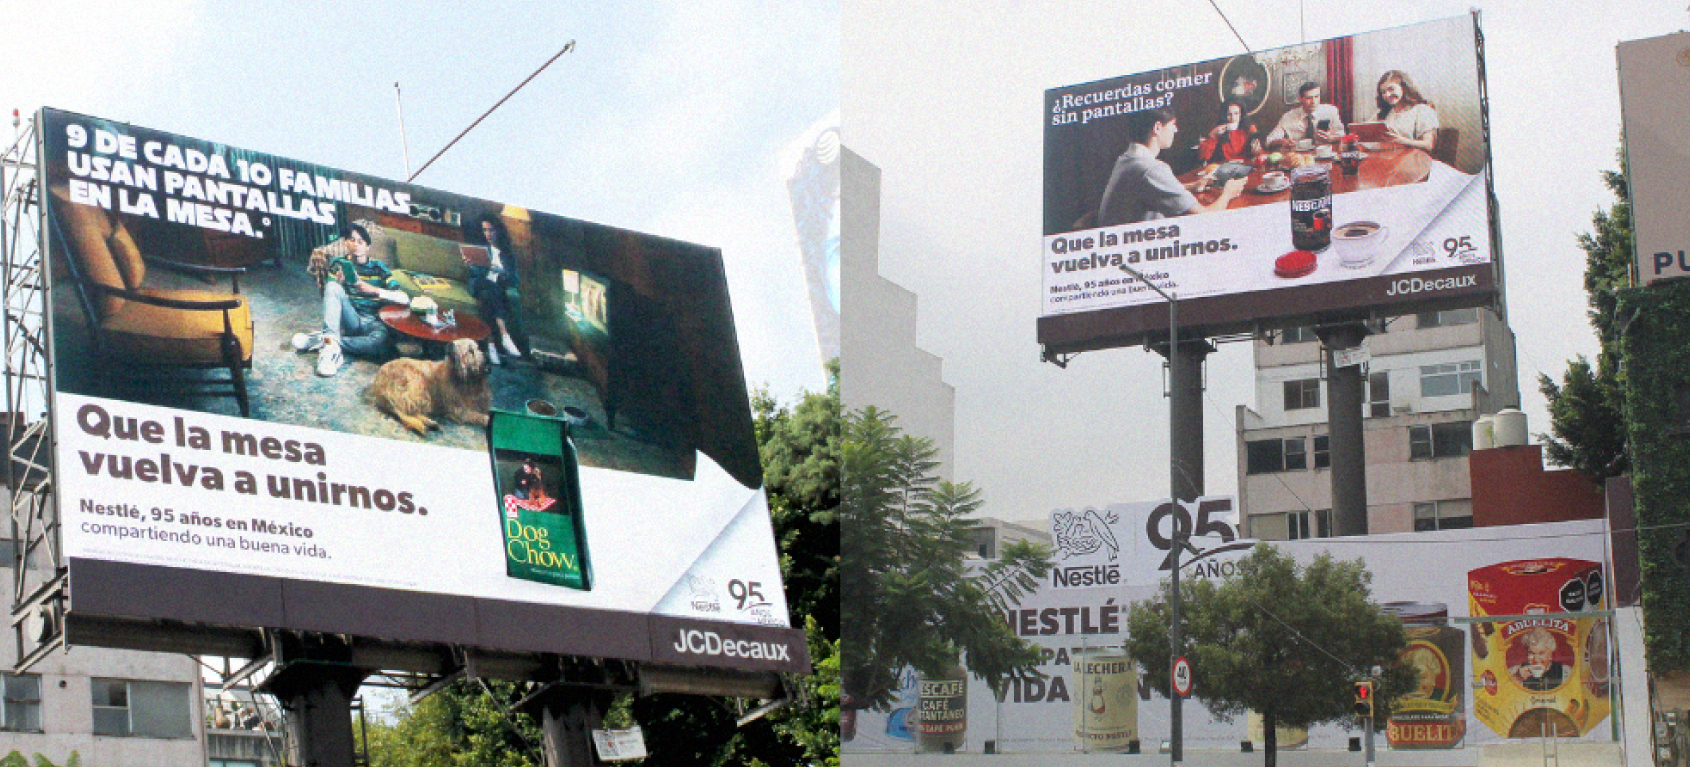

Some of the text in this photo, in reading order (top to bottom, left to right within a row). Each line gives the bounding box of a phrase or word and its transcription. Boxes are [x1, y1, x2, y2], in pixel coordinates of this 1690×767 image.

[1052, 72, 1213, 114] ¿Recuerdas comer
[1052, 92, 1175, 126] sin pantallas?
[65, 124, 411, 215] 9 DE CADA 10 FAMILIAS
[67, 150, 336, 225] USAN PANTALLAS
[69, 178, 112, 209] EN
[120, 188, 160, 219] LA
[1051, 224, 1180, 255] Que la mesa
[1051, 238, 1238, 274] vuelva a unirnos.
[1443, 235, 1472, 258] 95
[1654, 250, 1690, 275] PU
[1386, 274, 1477, 296] JCDecaux
[76, 403, 326, 466] Que la mesa
[78, 450, 428, 516] vuelva a unirnos.
[80, 498, 314, 539] Nestlé, 95 años en México
[507, 518, 550, 549] Dog
[1146, 499, 1236, 570] 95
[81, 522, 332, 560] compartiendo una buena vida.
[1053, 564, 1121, 588] Nestlé
[728, 579, 765, 610] 95
[673, 628, 791, 662] JCDecaux
